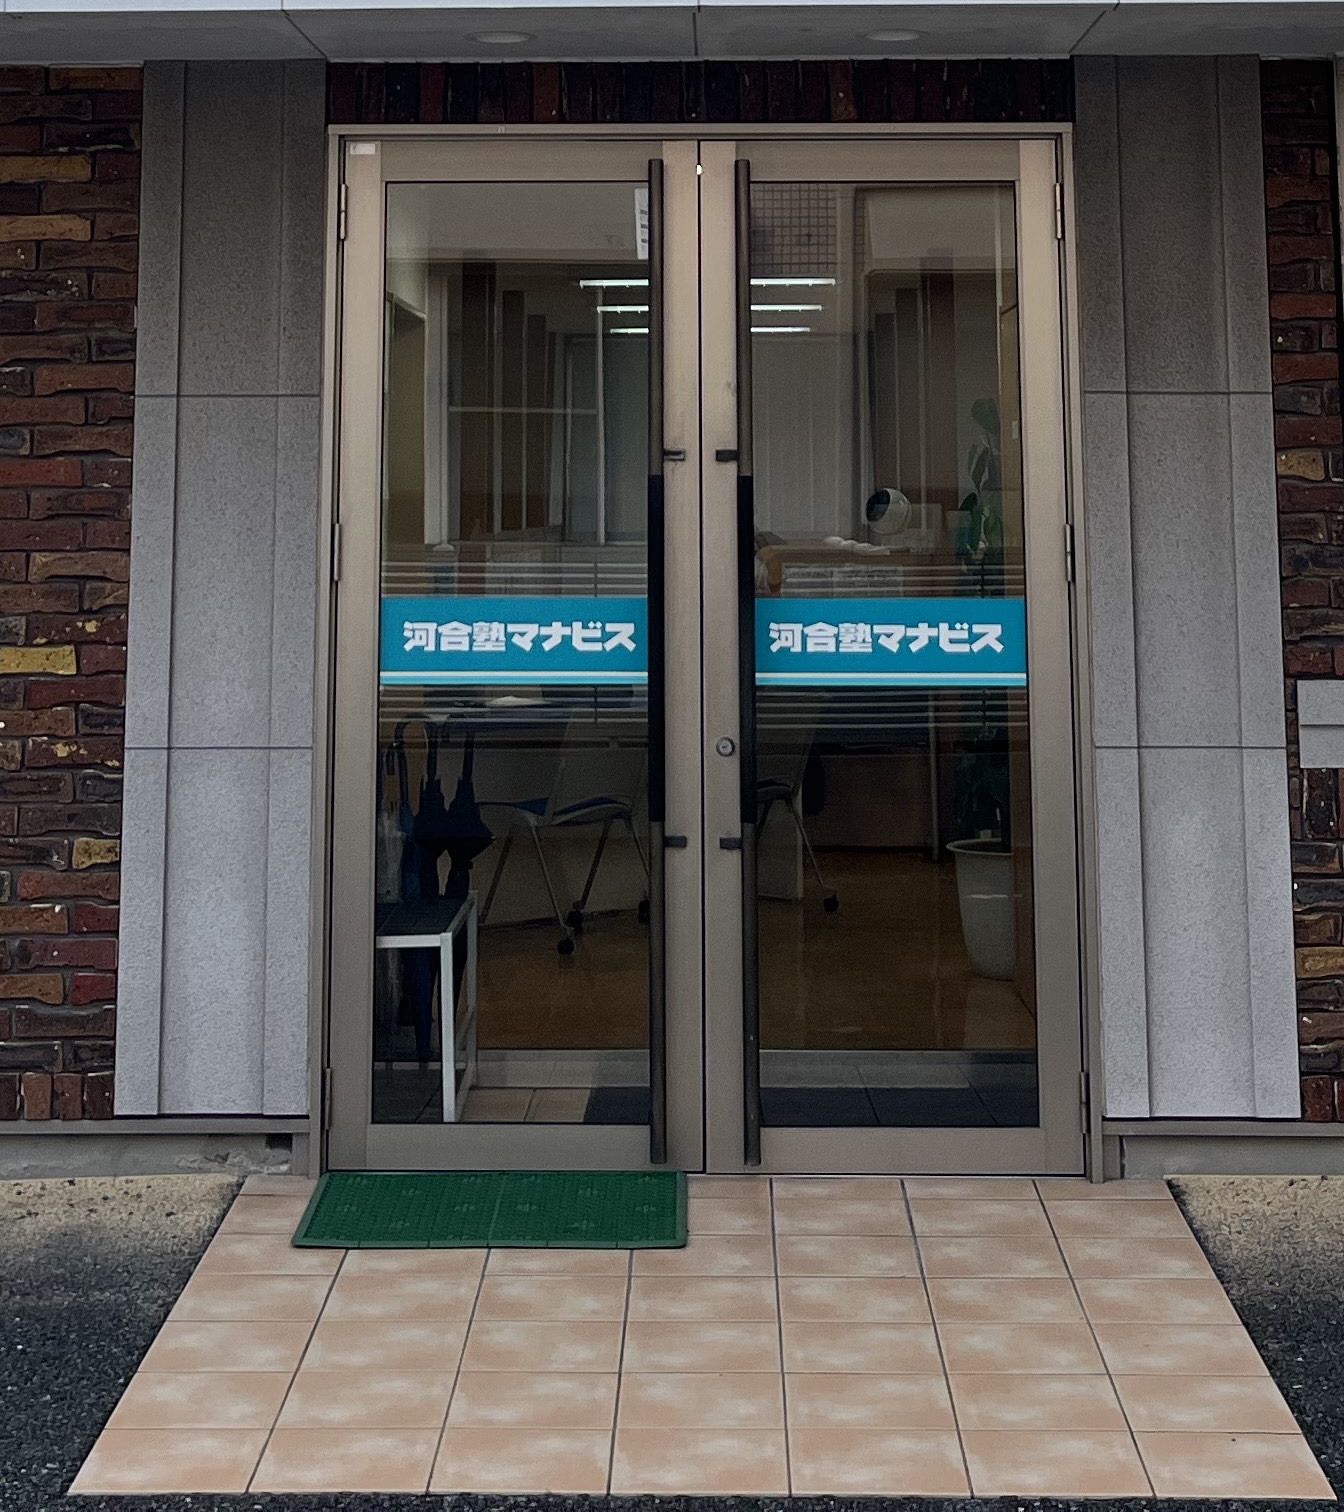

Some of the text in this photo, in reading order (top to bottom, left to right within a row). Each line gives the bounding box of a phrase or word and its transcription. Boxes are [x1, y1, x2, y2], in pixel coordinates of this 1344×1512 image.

[402, 620, 637, 653] 河合塾マナビス
[768, 620, 1004, 654] 河合塾マナビス
